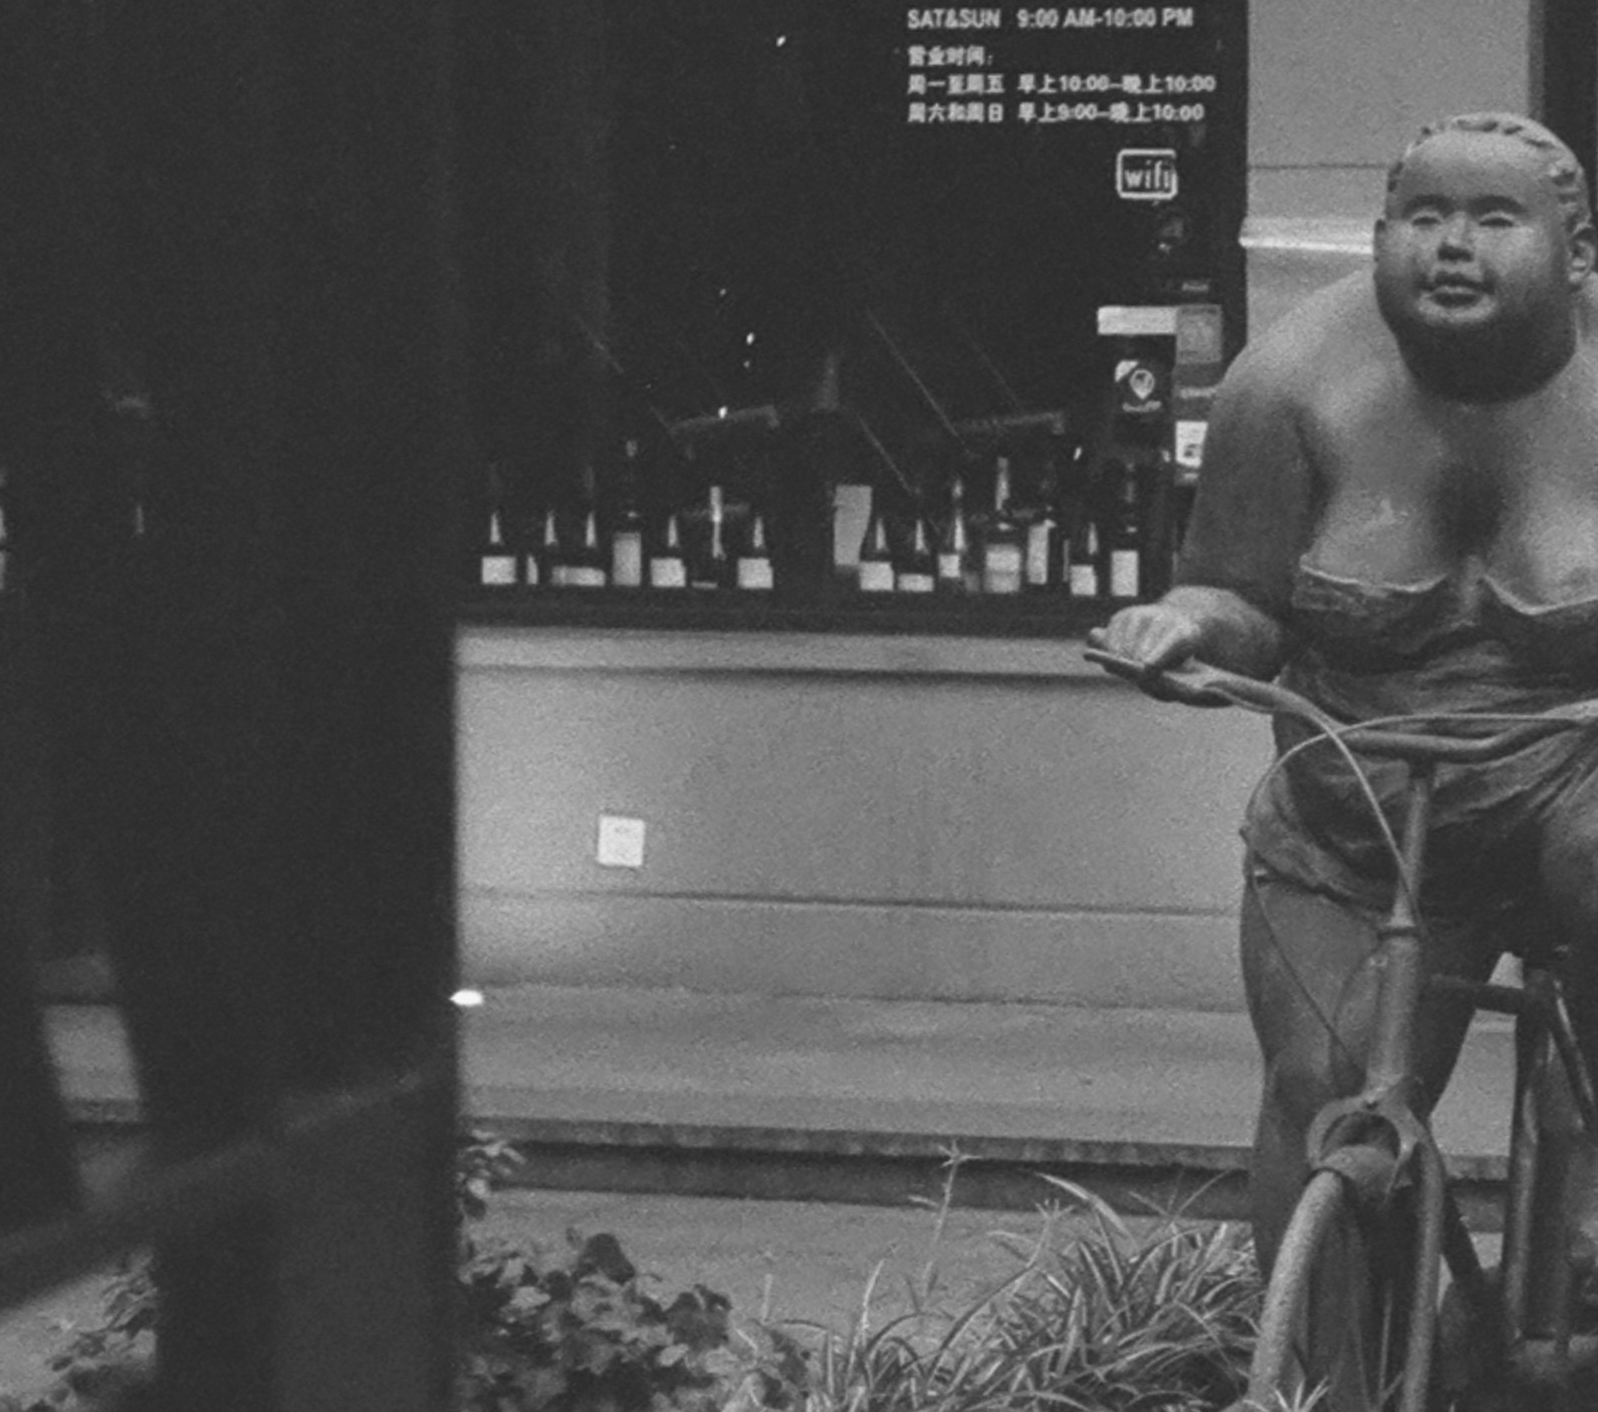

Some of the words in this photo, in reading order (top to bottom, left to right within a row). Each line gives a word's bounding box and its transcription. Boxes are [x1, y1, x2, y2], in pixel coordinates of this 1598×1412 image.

[906, 8, 1002, 29] SAT&SUN
[1016, 8, 1059, 29] 9:00
[1162, 7, 1194, 28] PM
[1124, 159, 1173, 190] wifi
